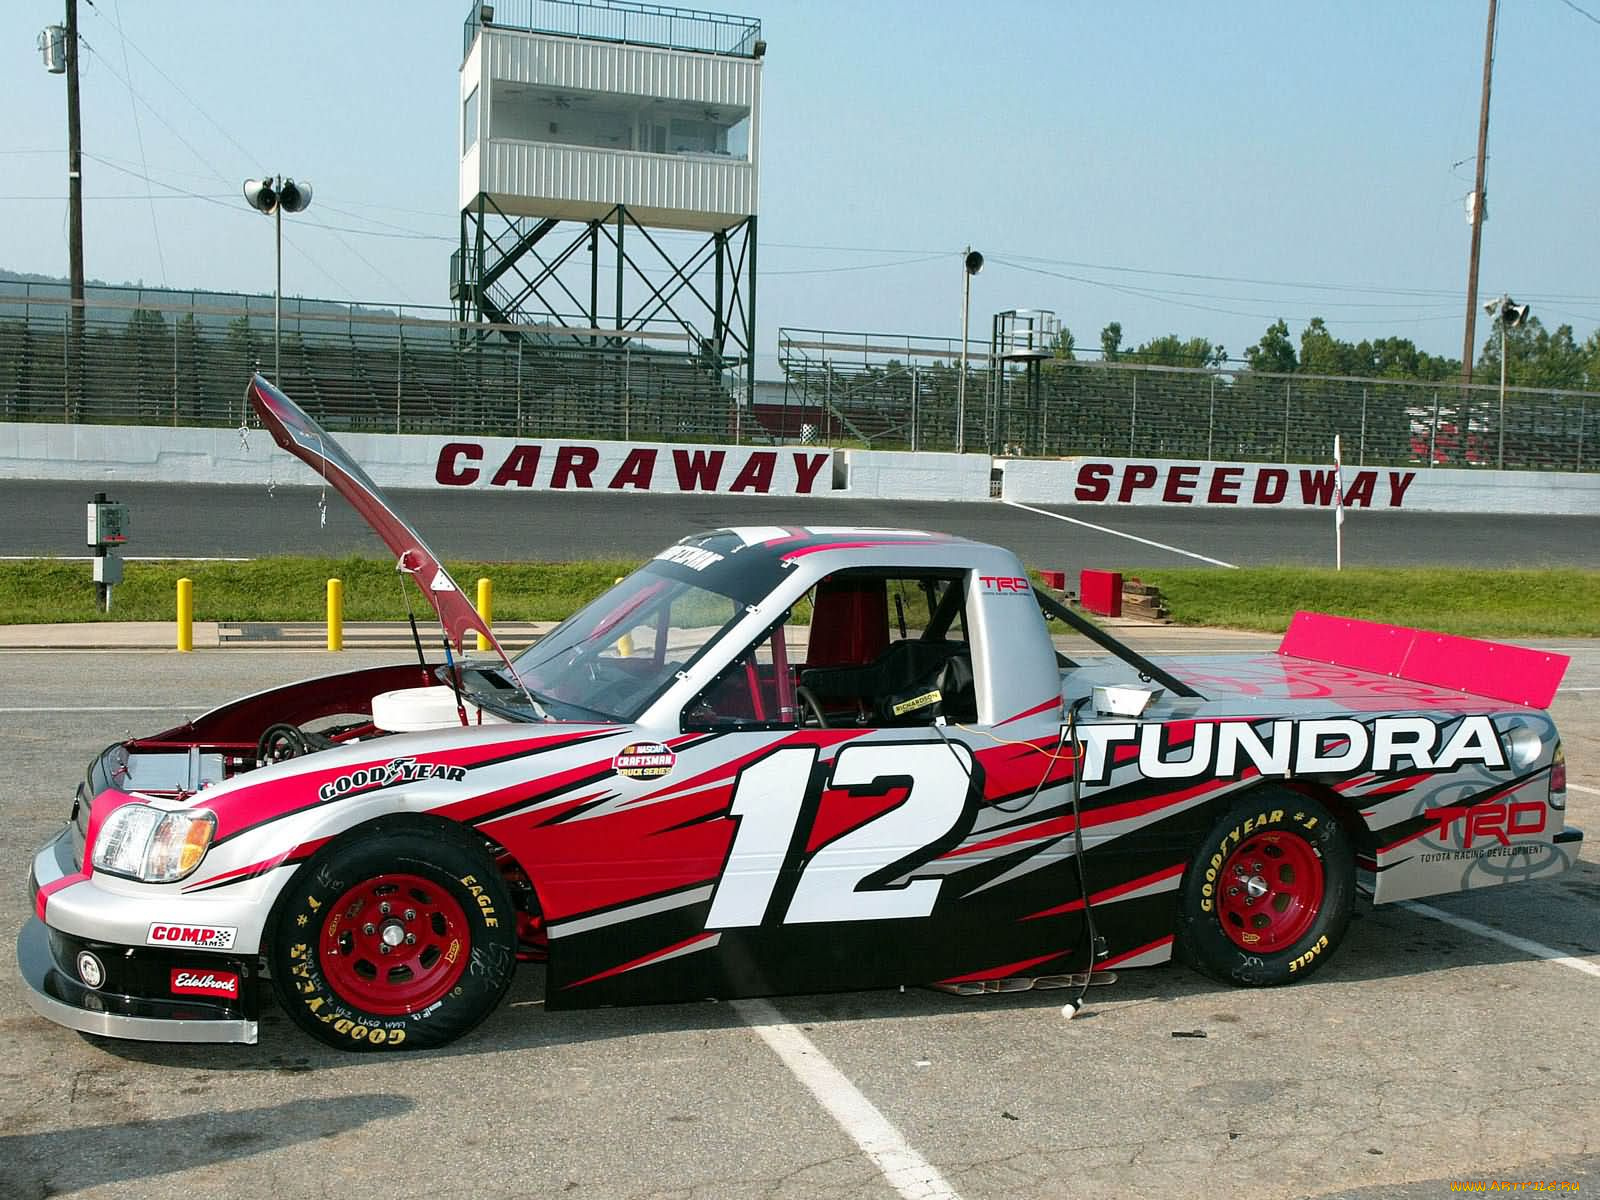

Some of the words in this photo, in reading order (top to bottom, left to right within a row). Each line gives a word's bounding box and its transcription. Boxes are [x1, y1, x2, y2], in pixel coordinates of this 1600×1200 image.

[435, 442, 830, 494] CARAWAY
[1074, 463, 1416, 507] SPEEDWAY
[979, 576, 1029, 592] TRD
[636, 745, 665, 754] NASCAR
[1062, 715, 1506, 782] TUNDRA
[617, 755, 673, 767] CRAFTSMAN
[619, 768, 643, 777] TRUCK
[643, 766, 673, 776] SERIES
[1424, 801, 1547, 848] TRD
[704, 743, 974, 930] 12
[1420, 853, 1451, 863] TOYOTA
[1454, 850, 1485, 860] RACING
[1487, 845, 1544, 858] DEVELOPMENT
[461, 873, 499, 928] EAGLE
[152, 926, 215, 943] COMP
[194, 938, 225, 947] CAMS
[1288, 935, 1329, 973] EAGLE
[175, 972, 236, 992] Edelbrock
